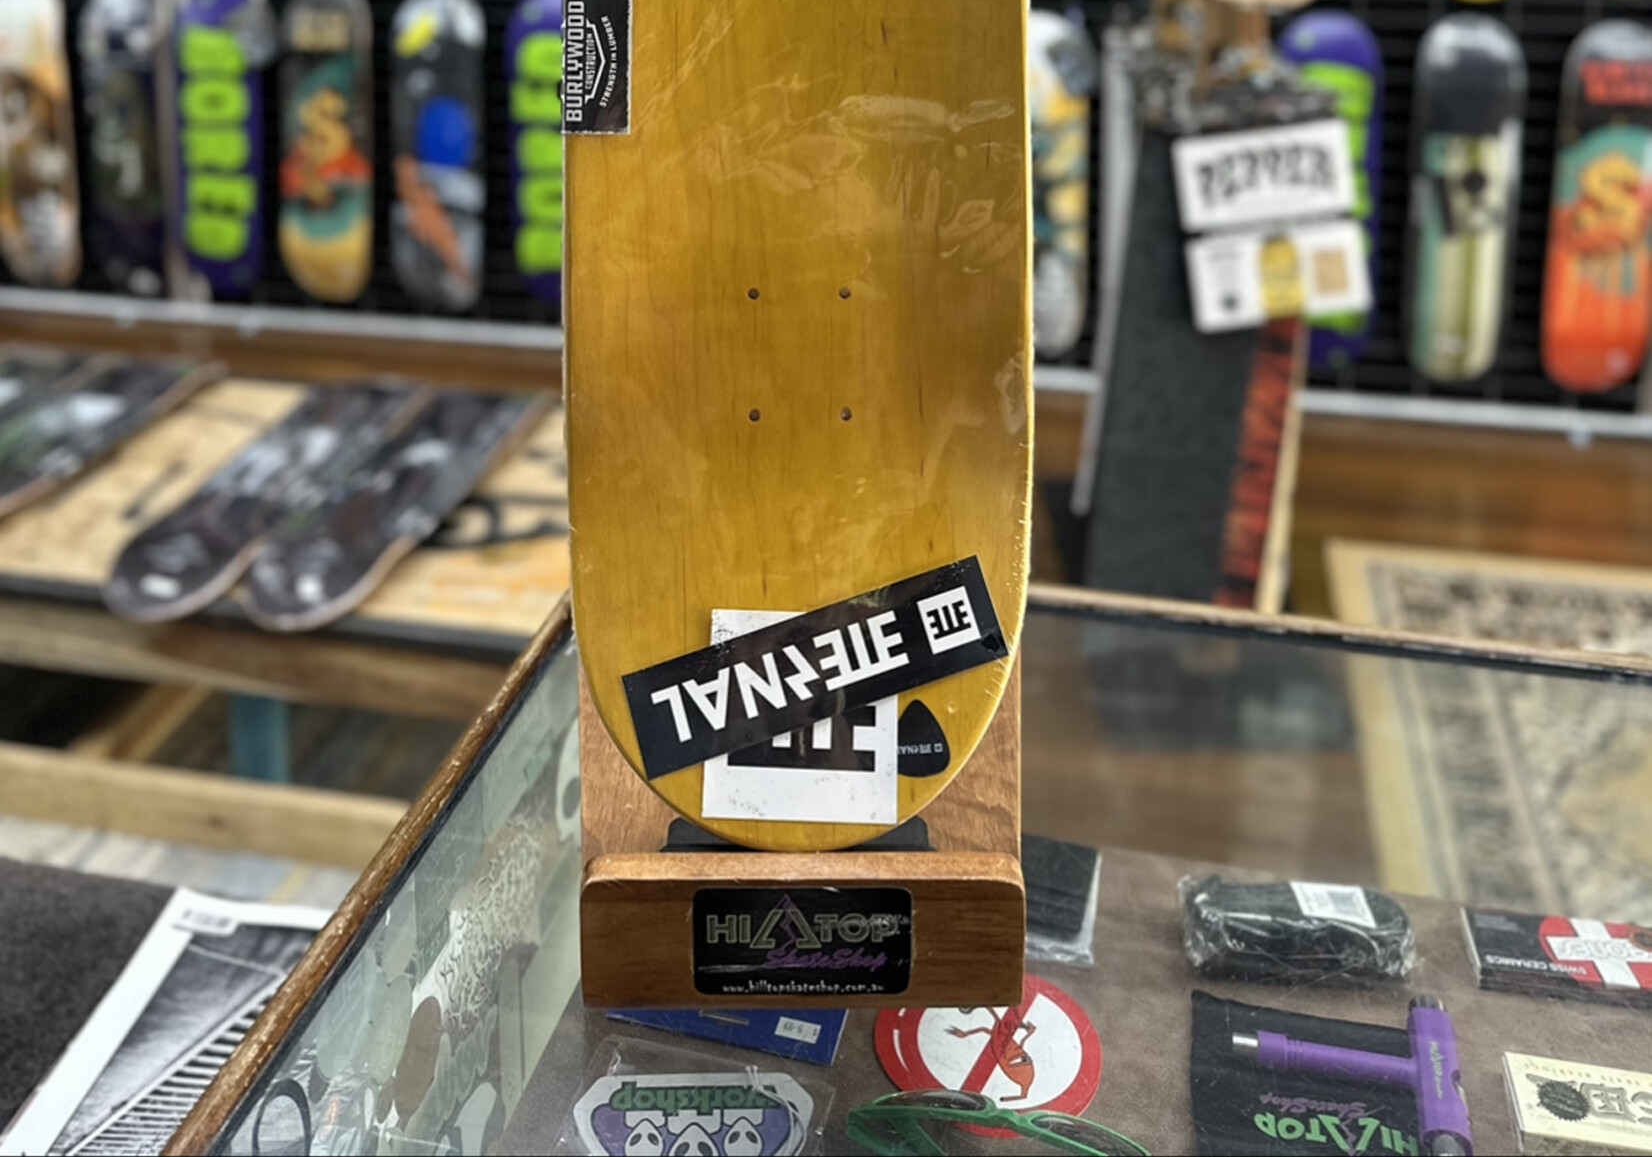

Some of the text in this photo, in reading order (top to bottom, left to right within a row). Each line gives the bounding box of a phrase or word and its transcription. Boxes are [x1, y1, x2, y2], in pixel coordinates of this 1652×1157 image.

[601, 15, 617, 51] LUMBER
[565, 1, 585, 122] BURLYWOOD
[585, 33, 597, 90] CONSTRUCTION
[599, 62, 618, 108] STRENGTH
[1485, 954, 1588, 975] SWISS CERAMICS
[722, 980, 885, 994] www.hilltopskateshop.com.au
